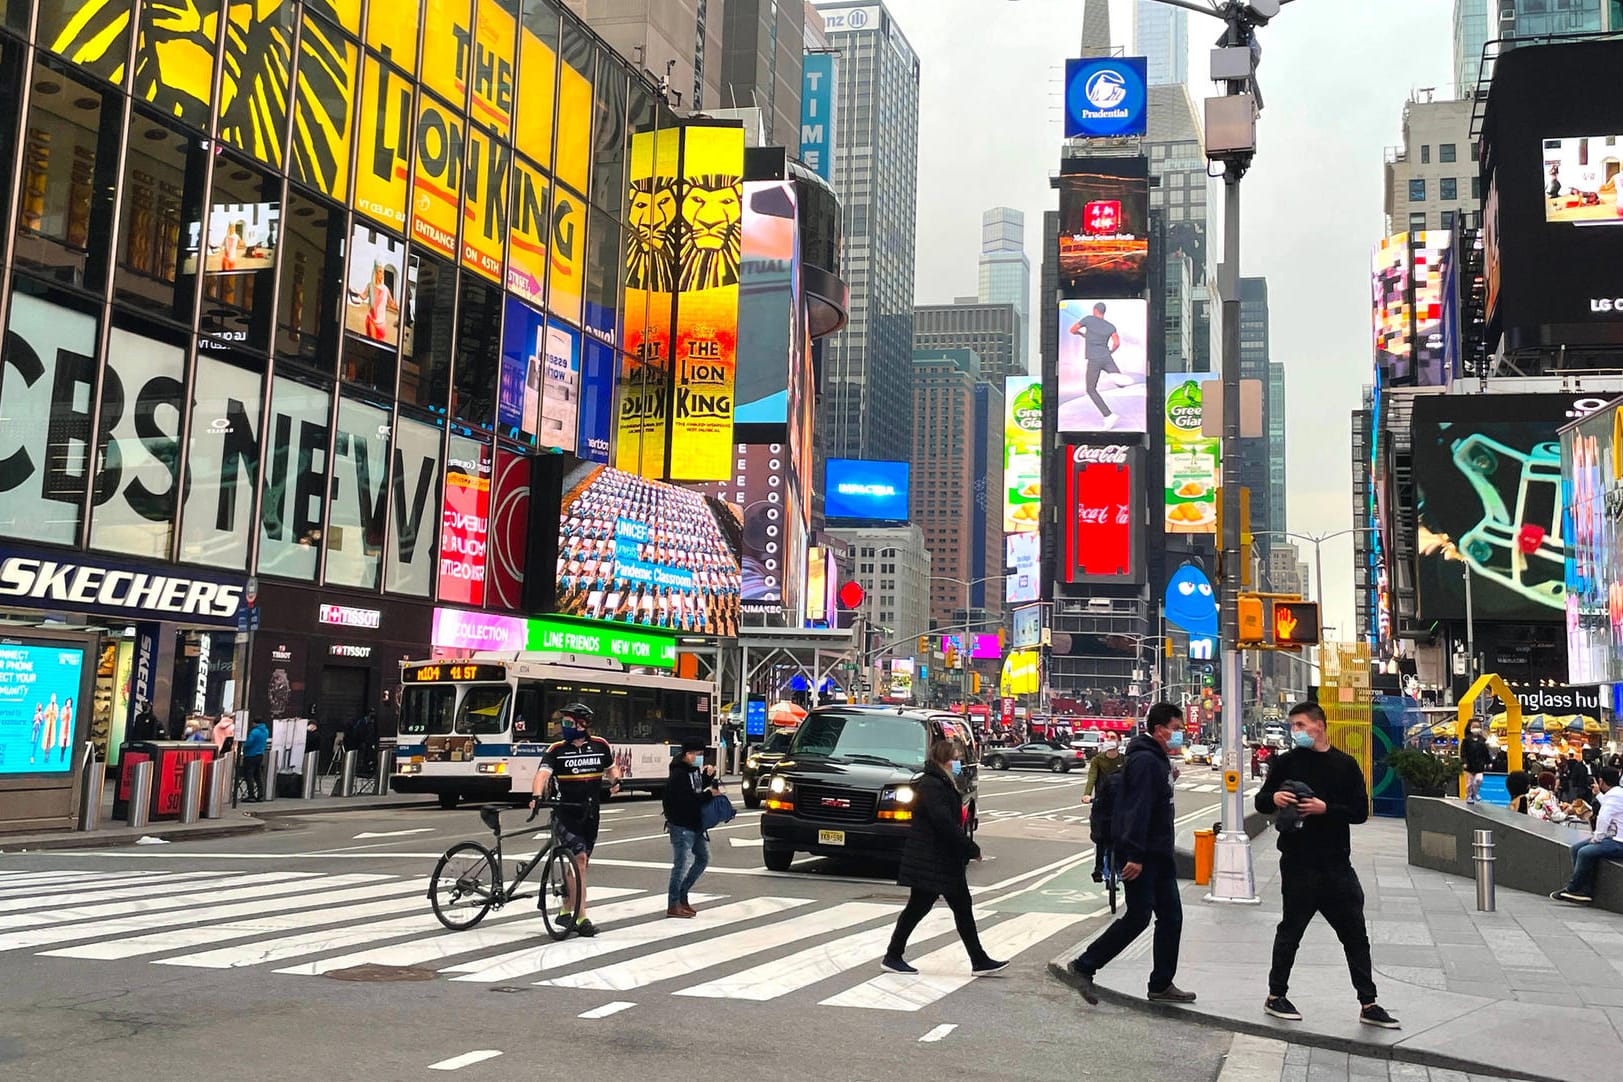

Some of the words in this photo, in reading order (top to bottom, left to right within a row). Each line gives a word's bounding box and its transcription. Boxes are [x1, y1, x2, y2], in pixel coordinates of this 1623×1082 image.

[452, 22, 512, 115] THE
[1082, 108, 1129, 118] Prudential
[373, 43, 480, 204] LION
[484, 121, 574, 262] KING
[415, 219, 456, 250] ENTRANCE
[465, 245, 478, 263] ON
[481, 253, 500, 275] 45TH
[1590, 299, 1612, 312] LG
[687, 341, 719, 356] THE
[681, 360, 725, 385] LION
[676, 387, 730, 419] KING
[216, 398, 436, 564] NEW
[616, 519, 647, 541] UNICEF
[614, 559, 652, 581] Pandemic
[653, 567, 692, 588] Classroom
[1, 557, 244, 618] SKECHERS
[455, 625, 508, 641] COLLECTION
[543, 631, 564, 647] LINE
[565, 633, 600, 652] FRIENDS
[611, 639, 630, 655] NEW
[631, 641, 651, 657] YORK
[343, 645, 371, 657] TISSOT
[450, 667, 462, 679] 41
[464, 666, 477, 679] ST
[1576, 691, 1600, 710] hu
[564, 757, 602, 768] COLOMBIA
